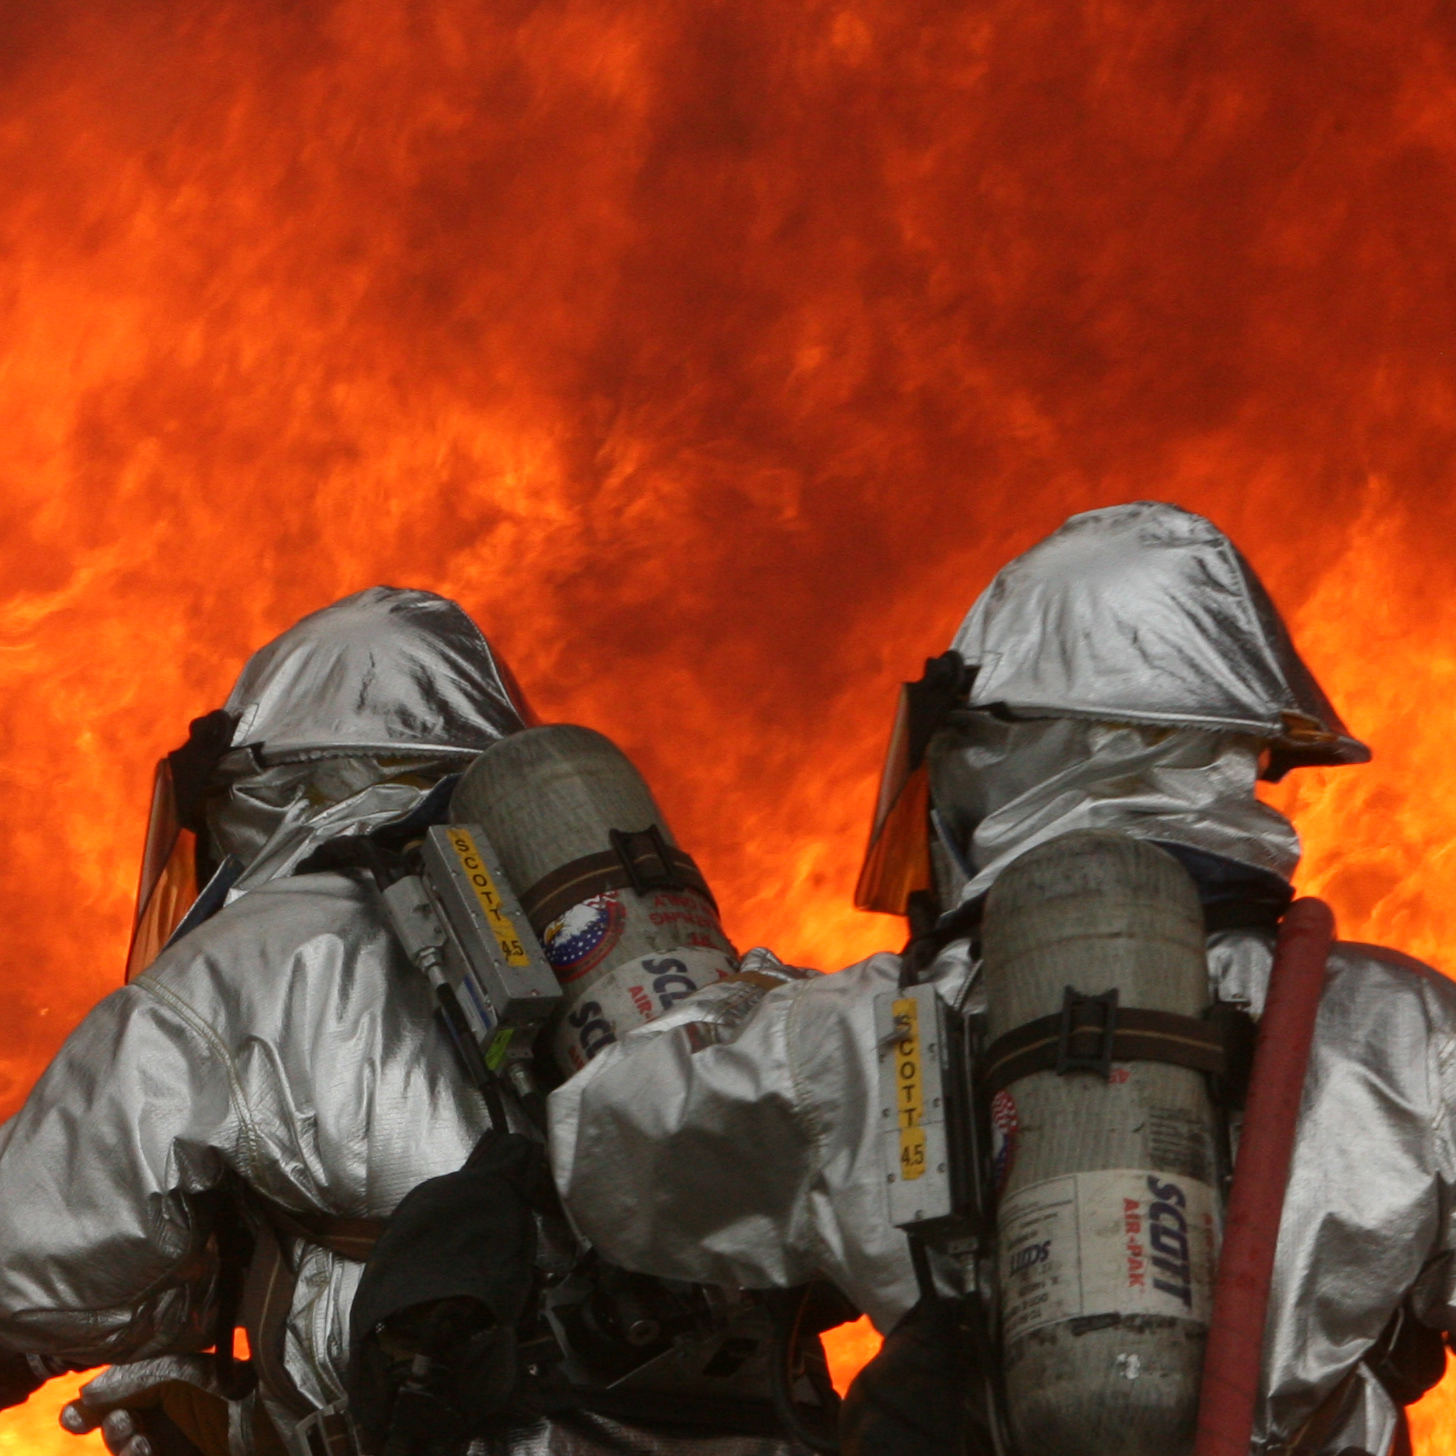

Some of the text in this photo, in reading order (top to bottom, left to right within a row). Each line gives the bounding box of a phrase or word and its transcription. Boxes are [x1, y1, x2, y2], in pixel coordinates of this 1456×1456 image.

[455, 839, 501, 921] SCOTT
[894, 1014, 916, 1127] SCOTT
[1122, 1197, 1145, 1288] AIR-PAK
[1147, 1174, 1193, 1310] SCOTT
